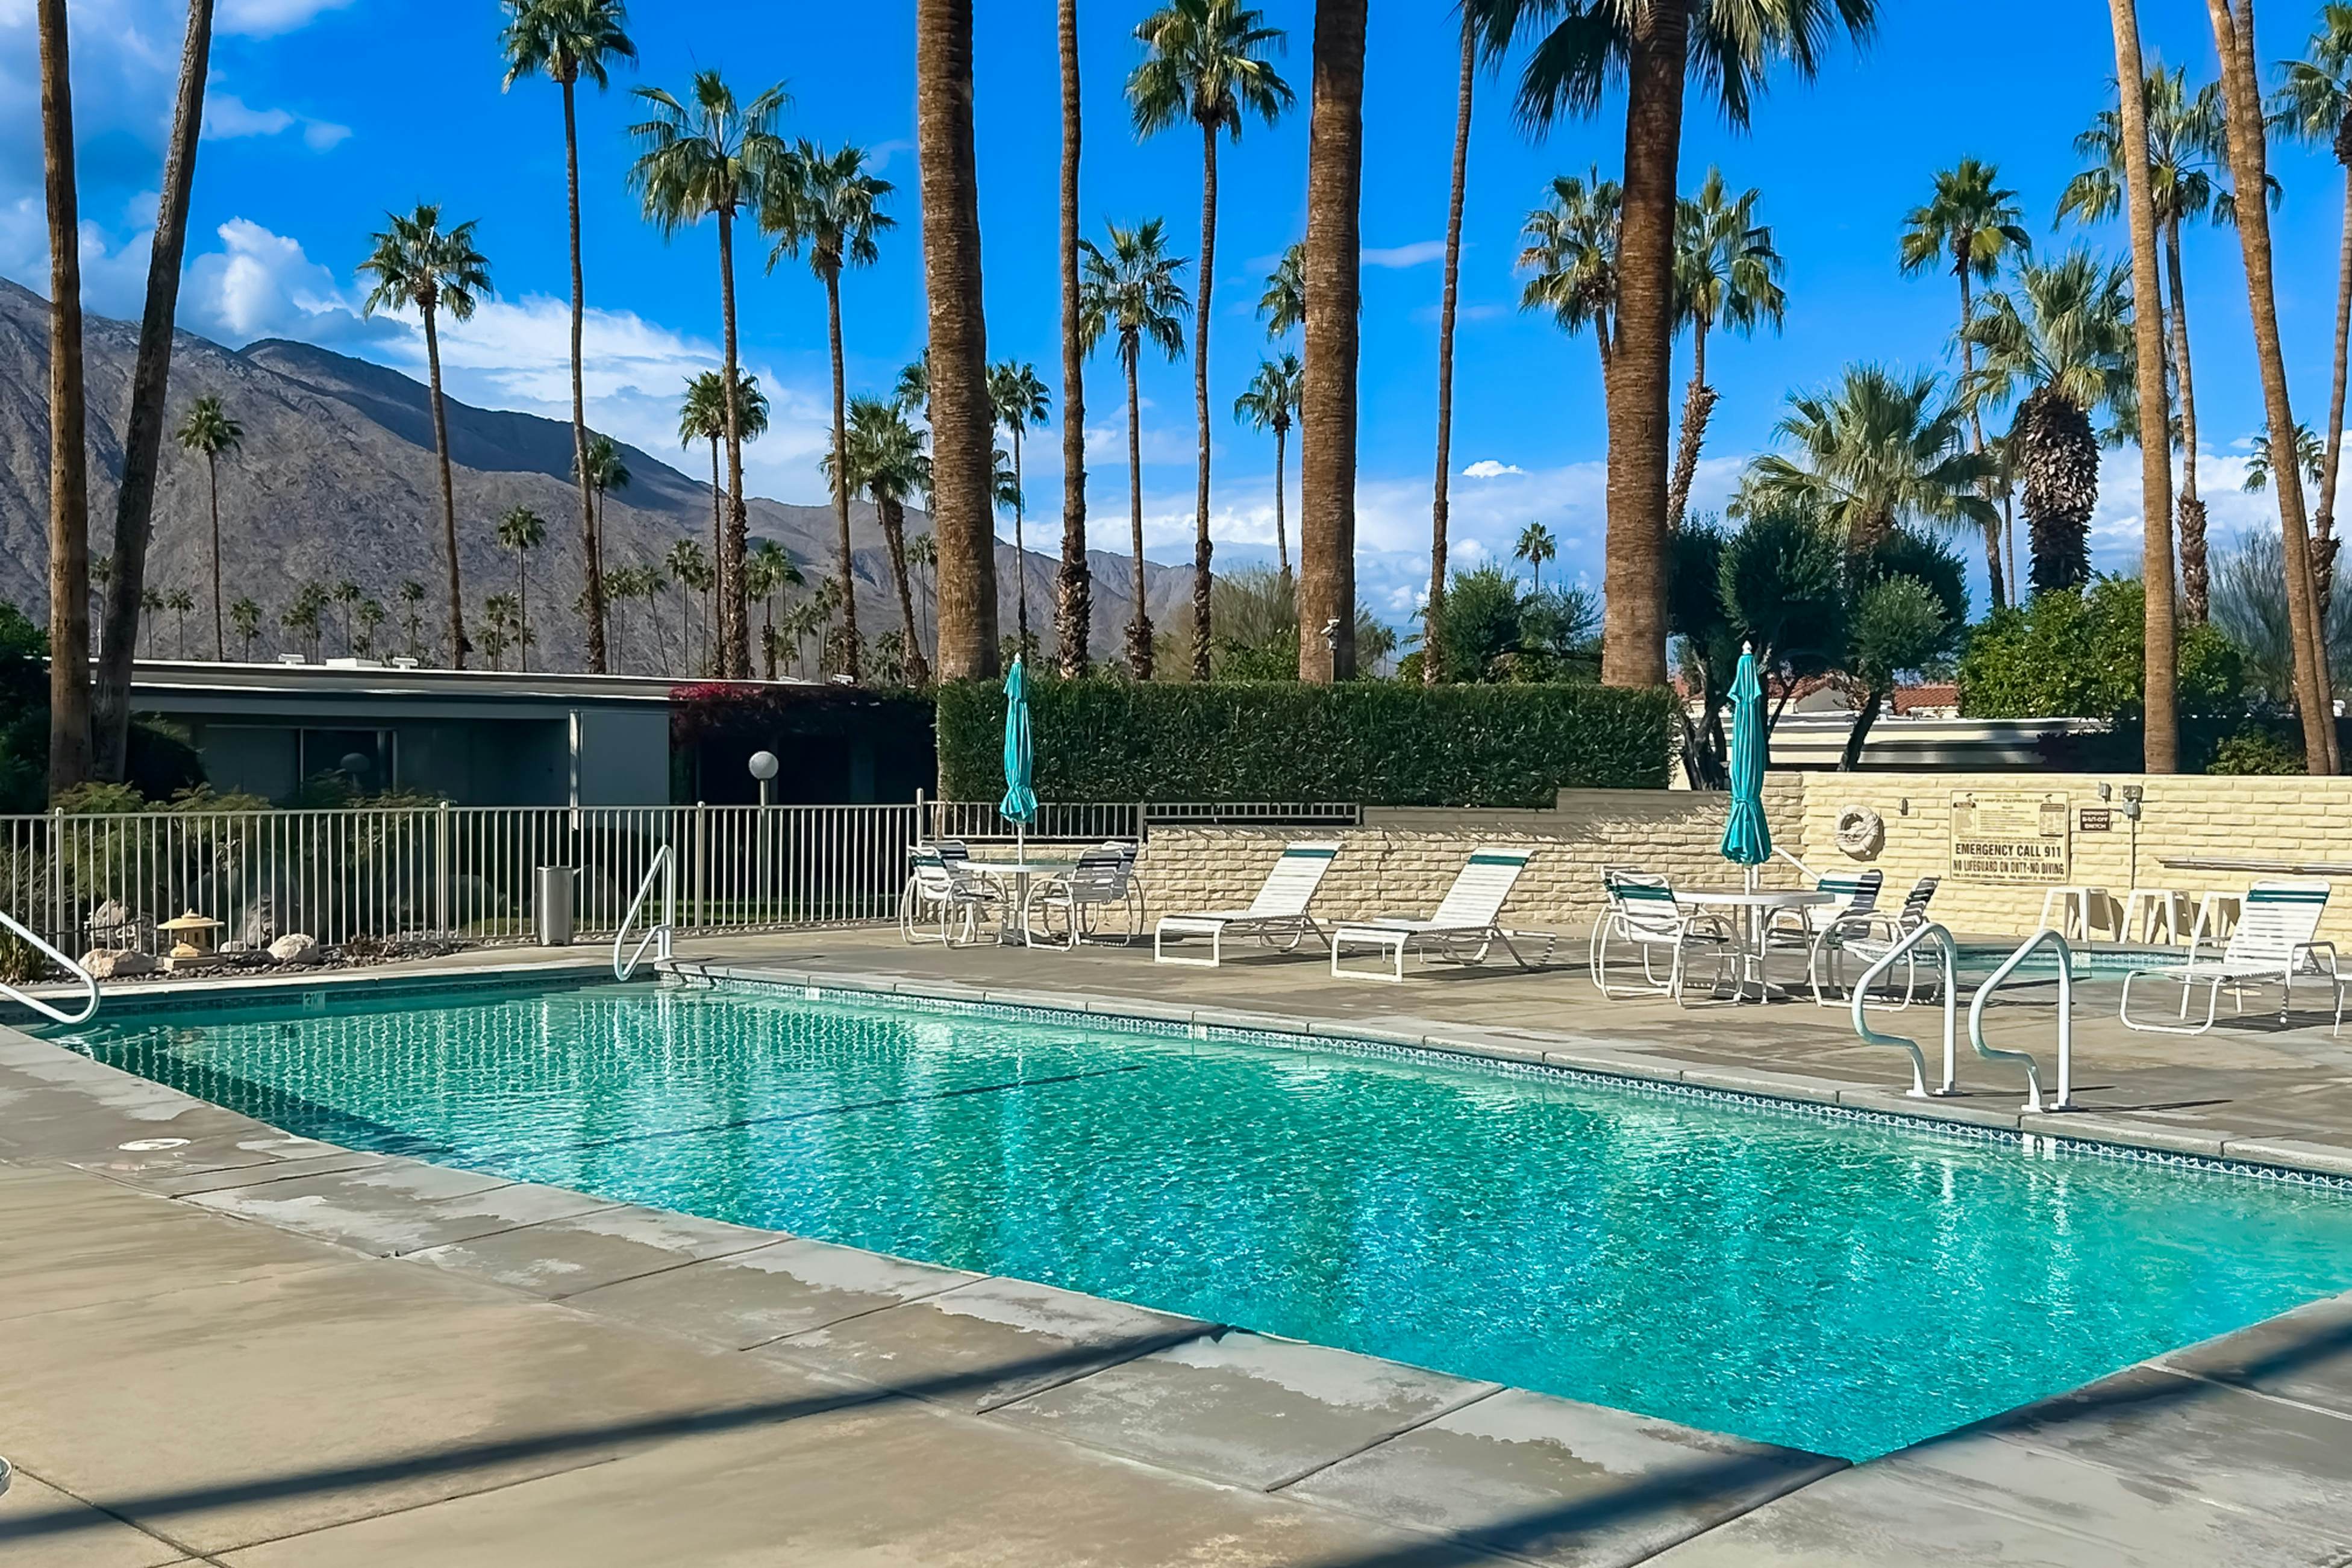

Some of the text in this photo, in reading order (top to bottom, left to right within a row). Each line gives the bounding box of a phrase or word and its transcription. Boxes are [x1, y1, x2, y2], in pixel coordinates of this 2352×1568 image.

[1956, 843, 2061, 858] EMERGENCY CALL 911
[1953, 860, 1962, 872] NO
[1963, 860, 1998, 872] LIFEGUARD
[2000, 861, 2009, 873] ON
[2041, 862, 2064, 875] DIVING
